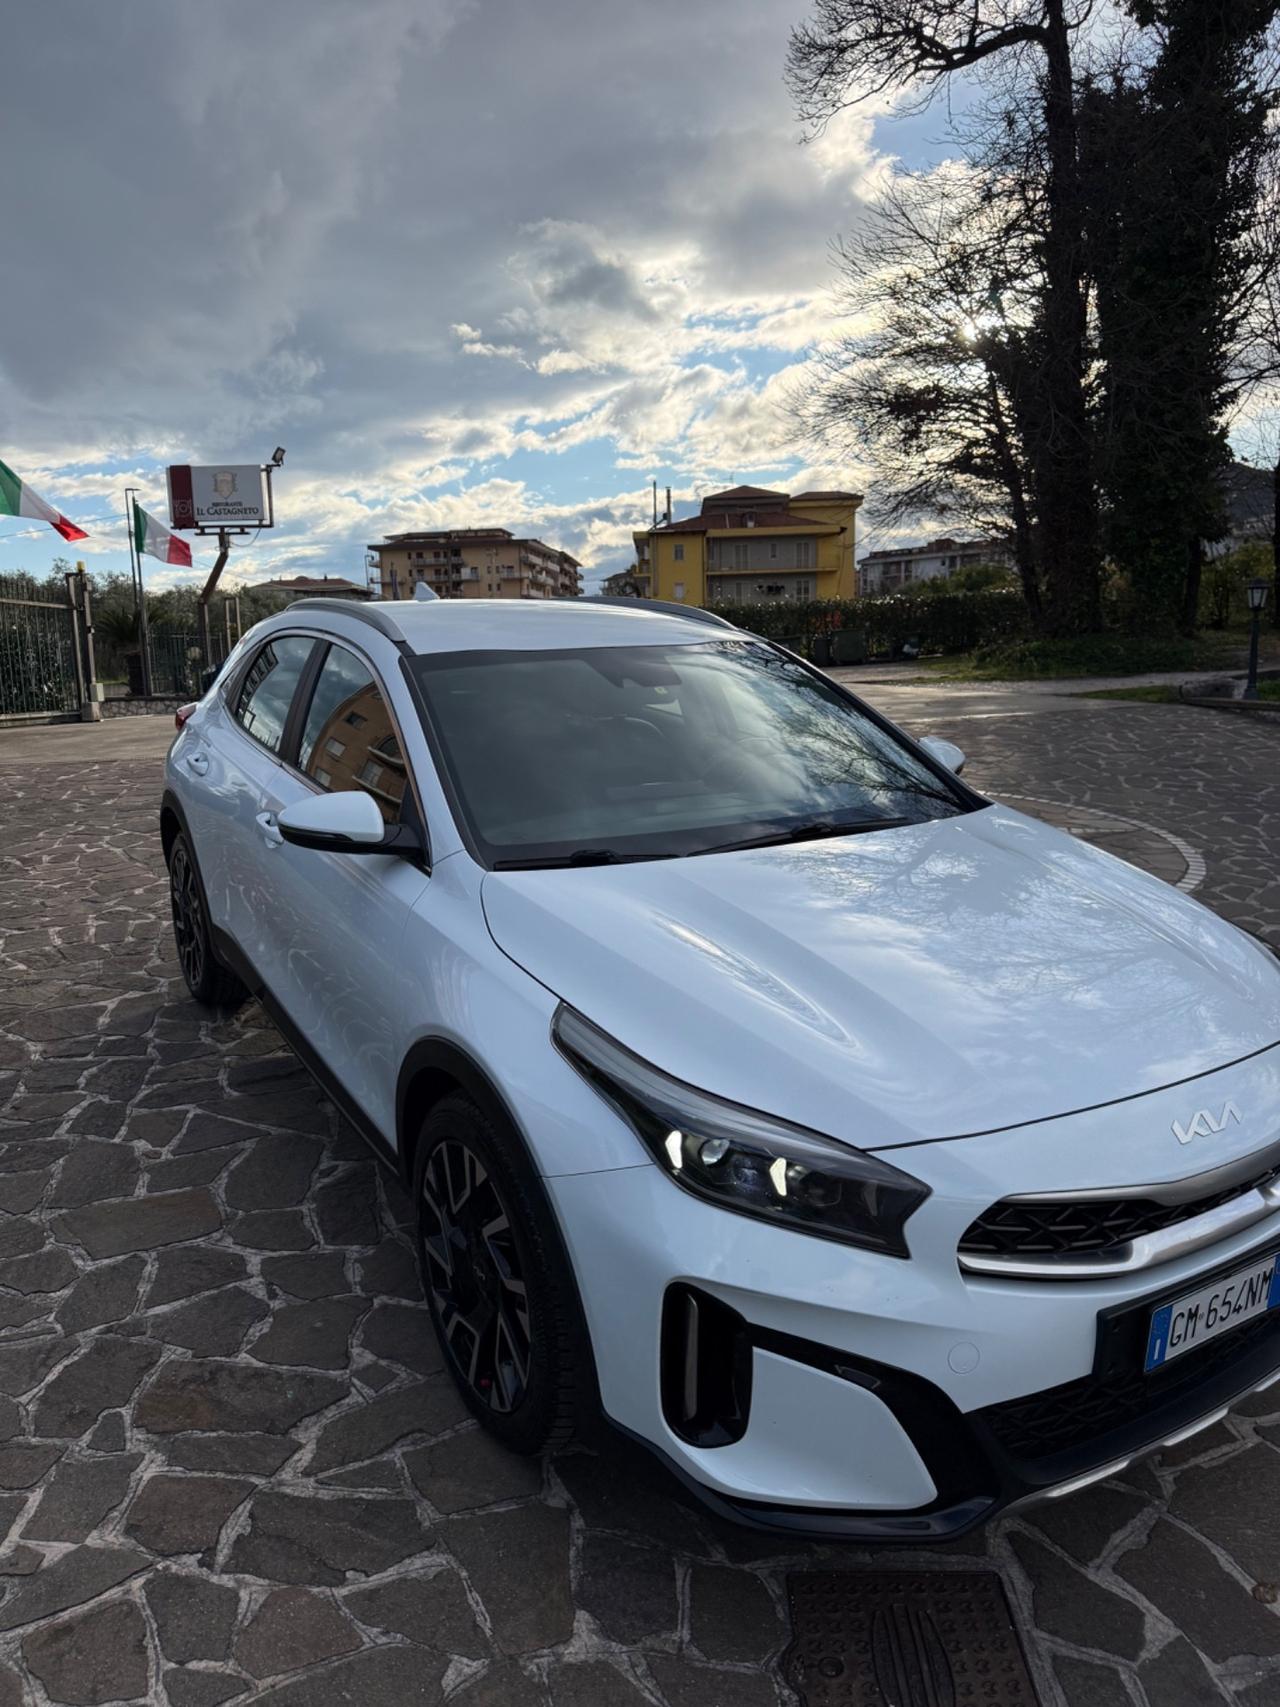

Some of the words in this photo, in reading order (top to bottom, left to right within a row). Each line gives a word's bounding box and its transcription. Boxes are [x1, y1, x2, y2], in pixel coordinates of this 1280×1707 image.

[197, 508, 205, 516] IL
[207, 507, 259, 516] CASTAGNETO
[1171, 1101, 1242, 1144] KIA
[1170, 1303, 1200, 1348] GM
[1205, 1267, 1274, 1329] 654NM
